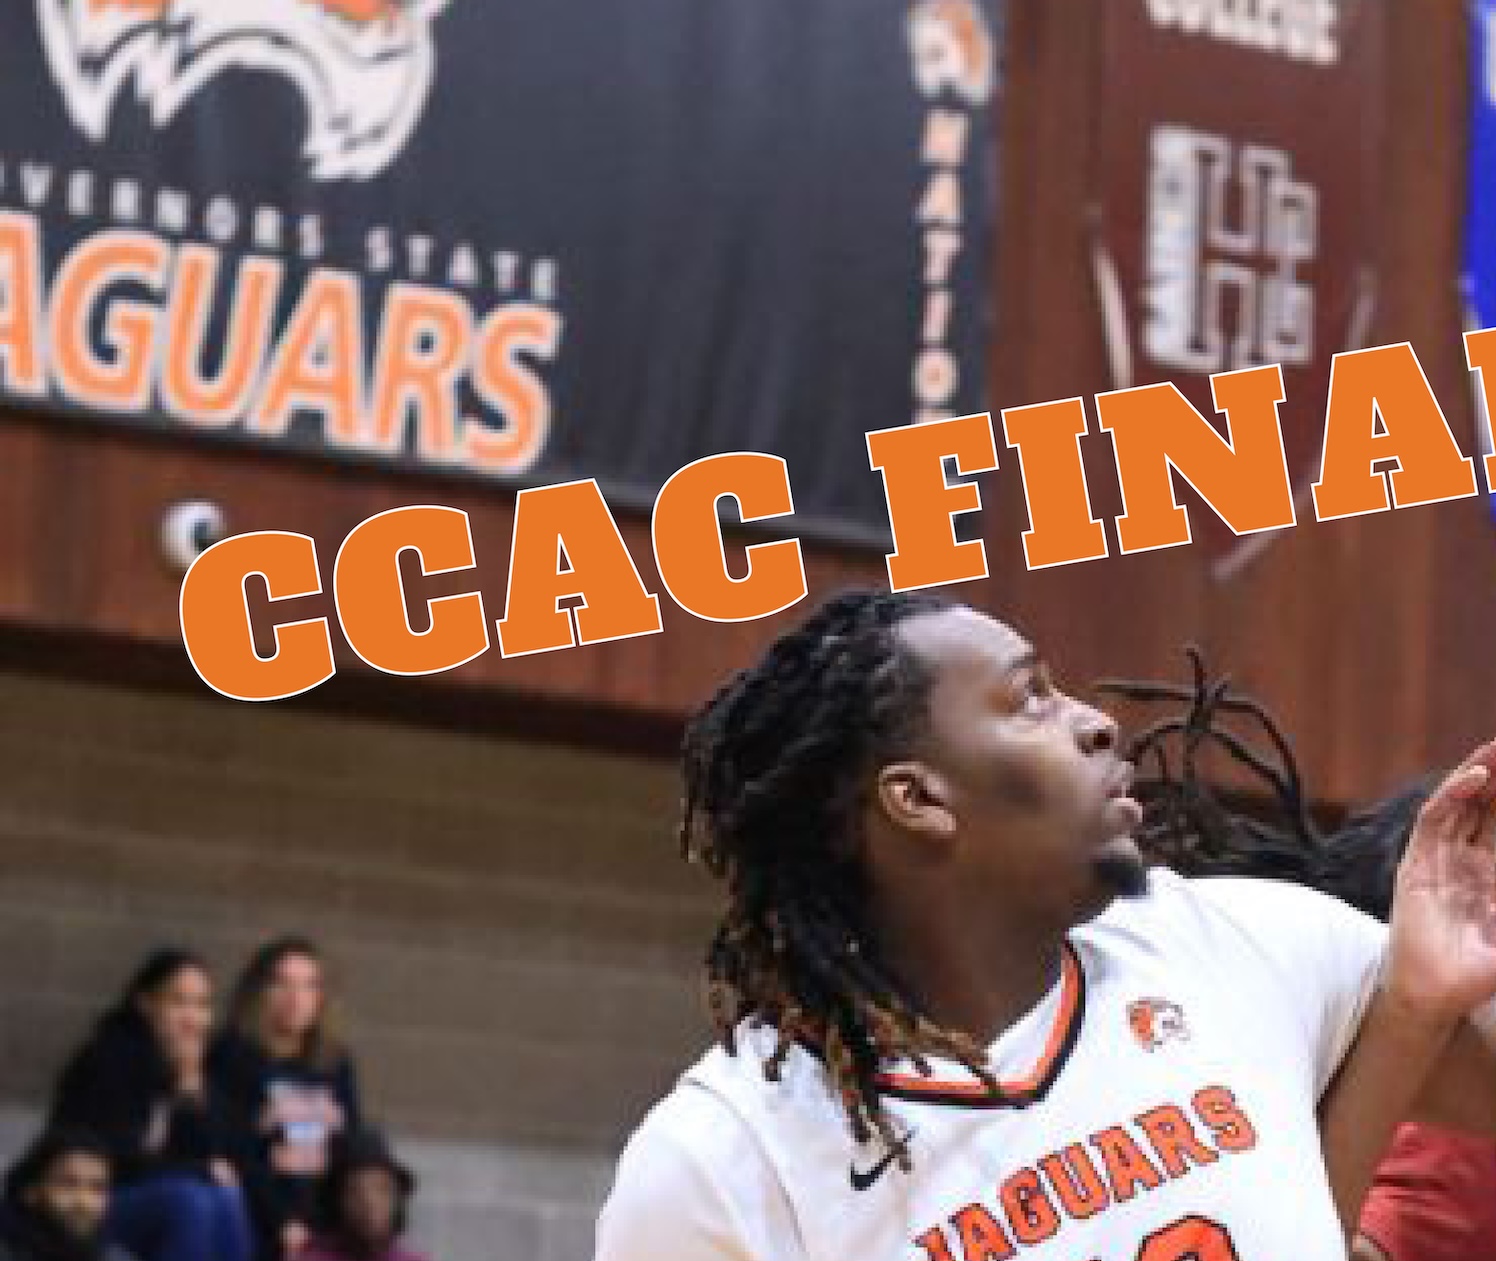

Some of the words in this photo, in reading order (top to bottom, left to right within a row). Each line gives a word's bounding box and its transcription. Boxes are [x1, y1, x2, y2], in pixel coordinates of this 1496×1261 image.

[0, 158, 324, 260] VERNORS
[363, 222, 560, 302] STATE
[912, 1083, 1260, 1261] JAGUARS
